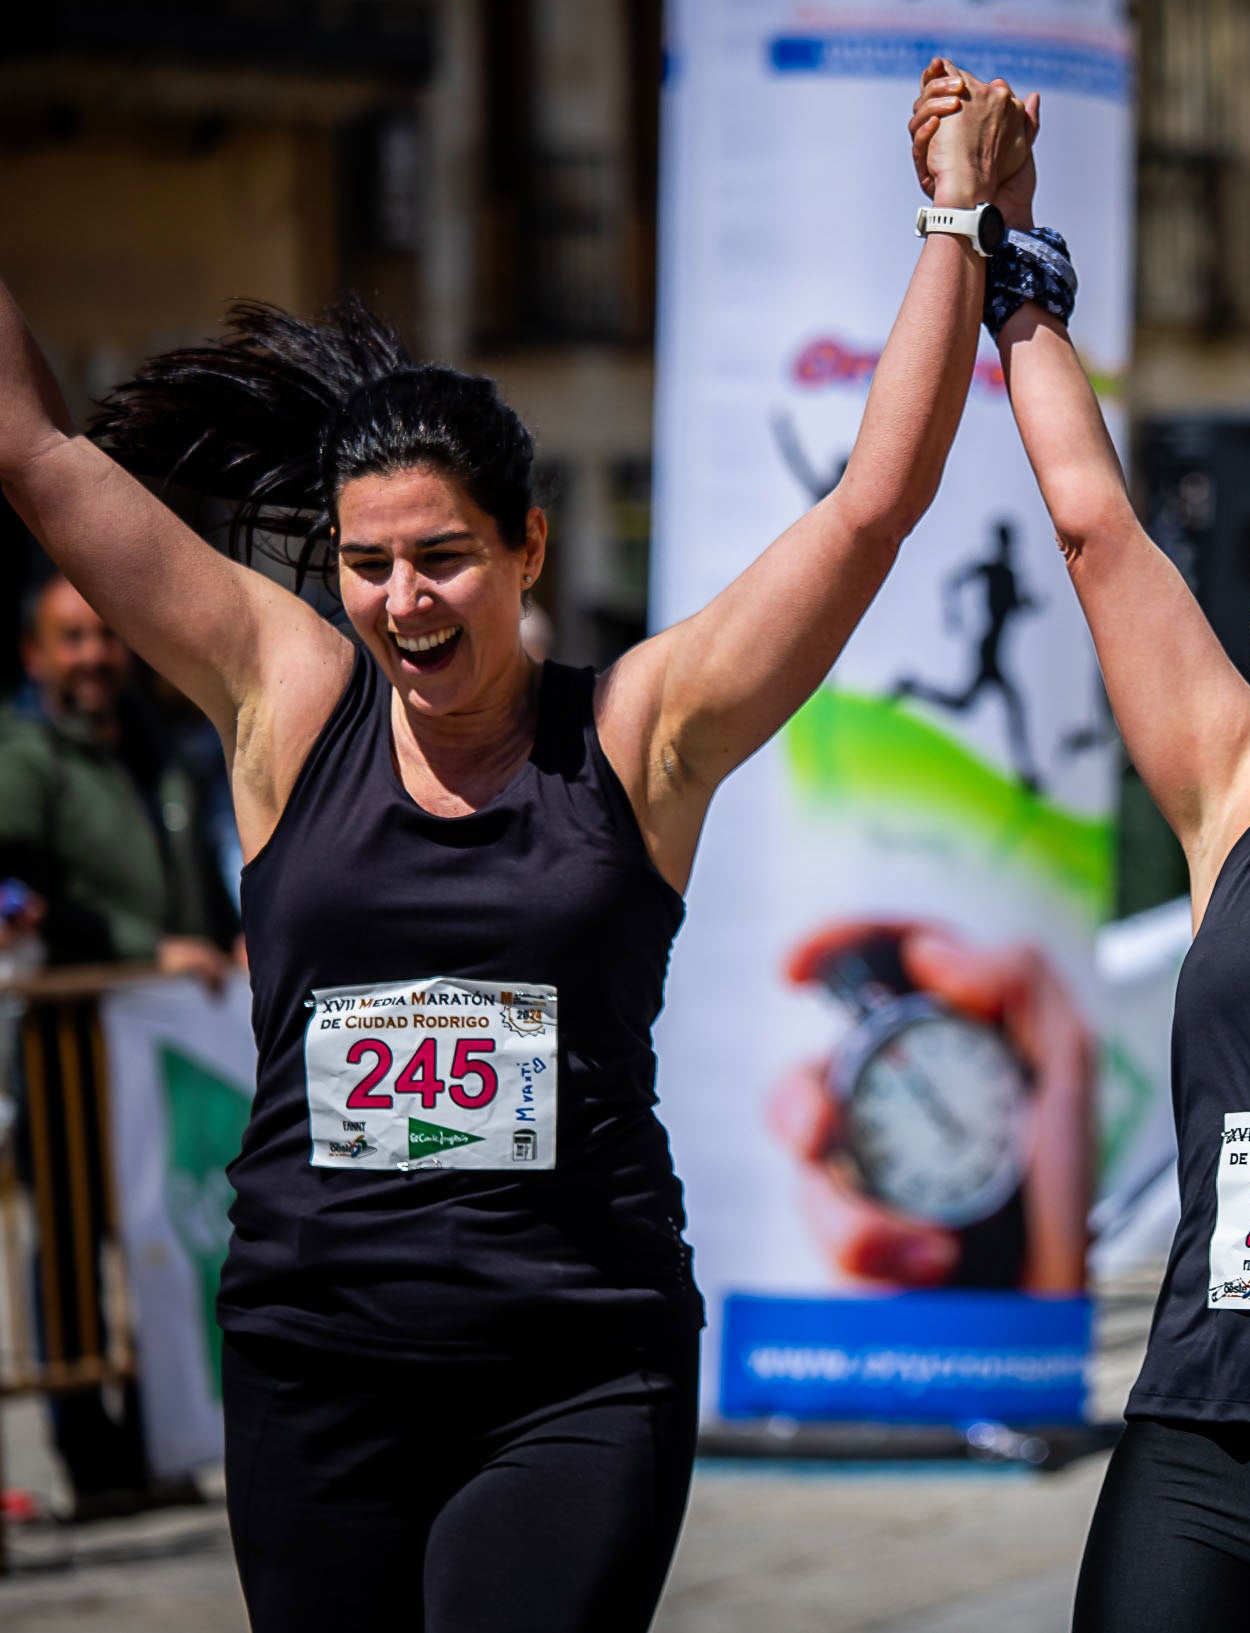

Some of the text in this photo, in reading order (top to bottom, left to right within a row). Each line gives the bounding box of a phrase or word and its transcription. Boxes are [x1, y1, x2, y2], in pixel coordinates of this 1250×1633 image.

[322, 991, 495, 1013] XVII MEDIA MARATÓN
[320, 1014, 490, 1030] DE CIUDAD RODRIGO
[346, 1037, 498, 1109] 245
[342, 1120, 366, 1132] FANNY
[1229, 1153, 1247, 1165] DE
